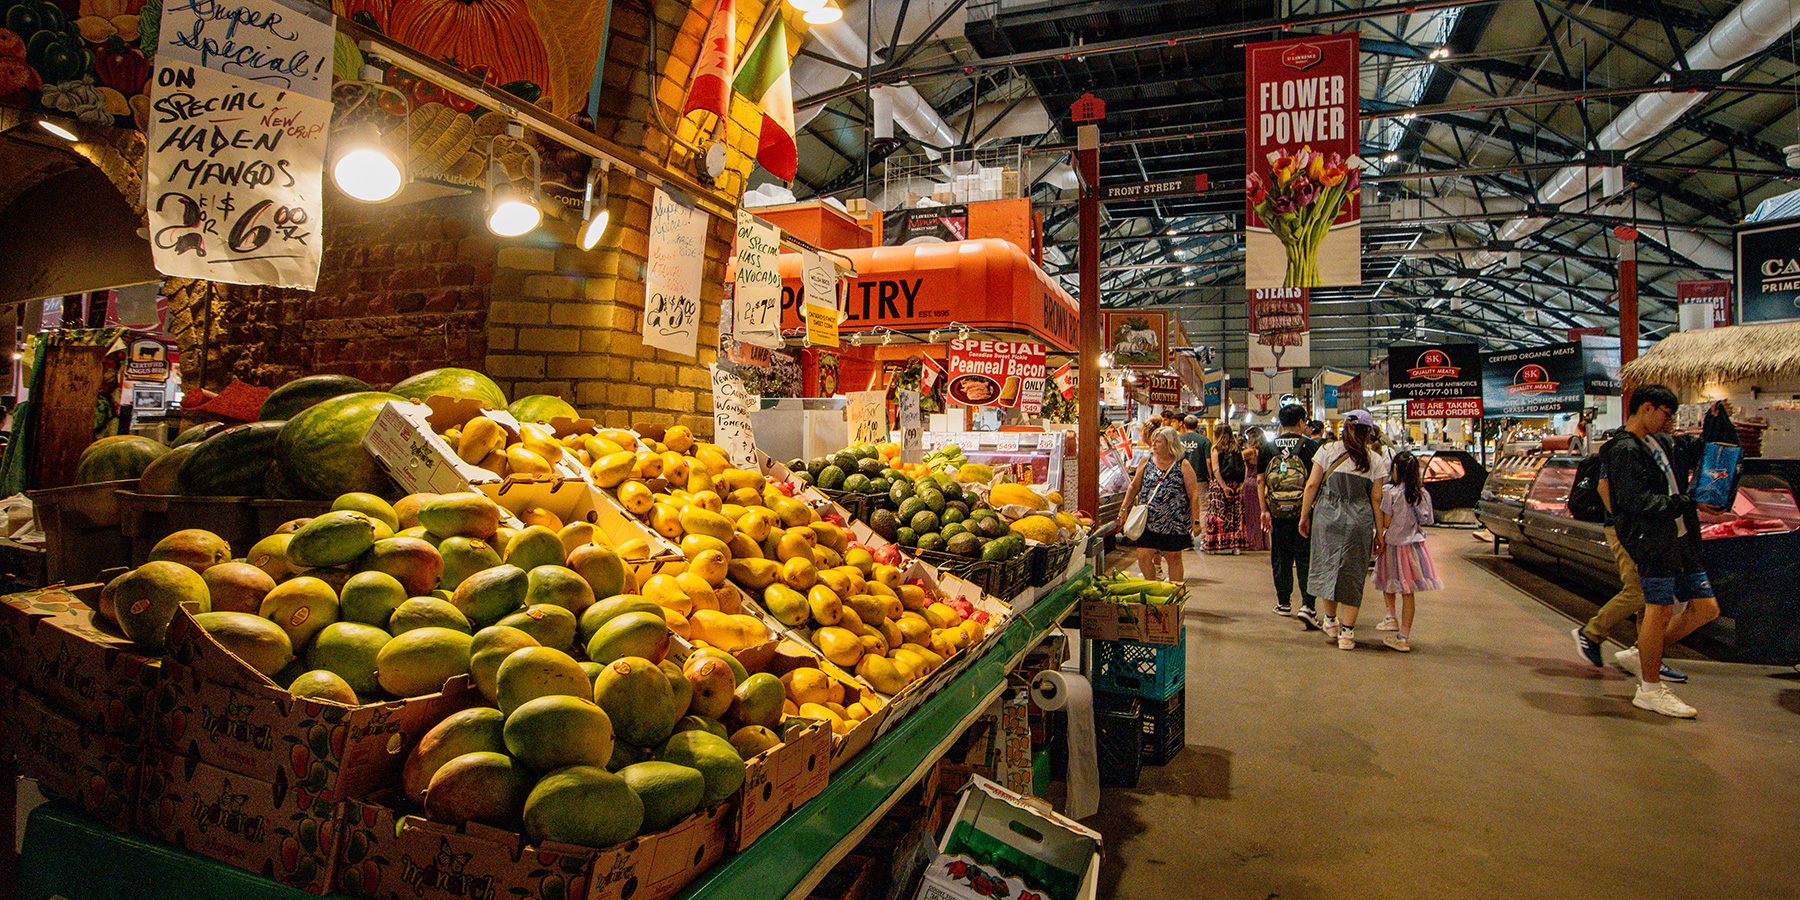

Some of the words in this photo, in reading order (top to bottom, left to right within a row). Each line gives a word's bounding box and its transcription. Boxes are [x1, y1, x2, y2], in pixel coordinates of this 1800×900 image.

[158, 67, 195, 88] ON
[1260, 75, 1344, 112] FLOWER
[260, 108, 302, 127] NEW
[1260, 107, 1344, 146] POWER
[157, 124, 284, 157] HADEN
[168, 159, 295, 189] MANGOS
[1108, 186, 1141, 196] FRONT
[1143, 181, 1182, 193] STREET
[738, 226, 753, 238] ON
[738, 249, 761, 270] HASS
[934, 310, 950, 318] 1895
[751, 346, 768, 362] LAMB
[951, 339, 1045, 355] SPECIAL
[1426, 354, 1439, 362] SK
[1488, 354, 1517, 363] CERTIFIED
[1519, 351, 1551, 360] ORGANIC
[1553, 347, 1575, 356] MEATS
[950, 355, 1004, 374] Peameal
[1007, 359, 1045, 377] Bacon
[1524, 369, 1538, 378] SK
[1024, 380, 1044, 391] ONLY
[1151, 376, 1178, 390] DELI
[1510, 385, 1533, 394] QUALITY
[1150, 392, 1178, 402] COUNTER
[1527, 394, 1580, 404] HORMONE-FREE
[1445, 408, 1480, 416] ORDERS
[1503, 405, 1539, 413] GRASS-FED
